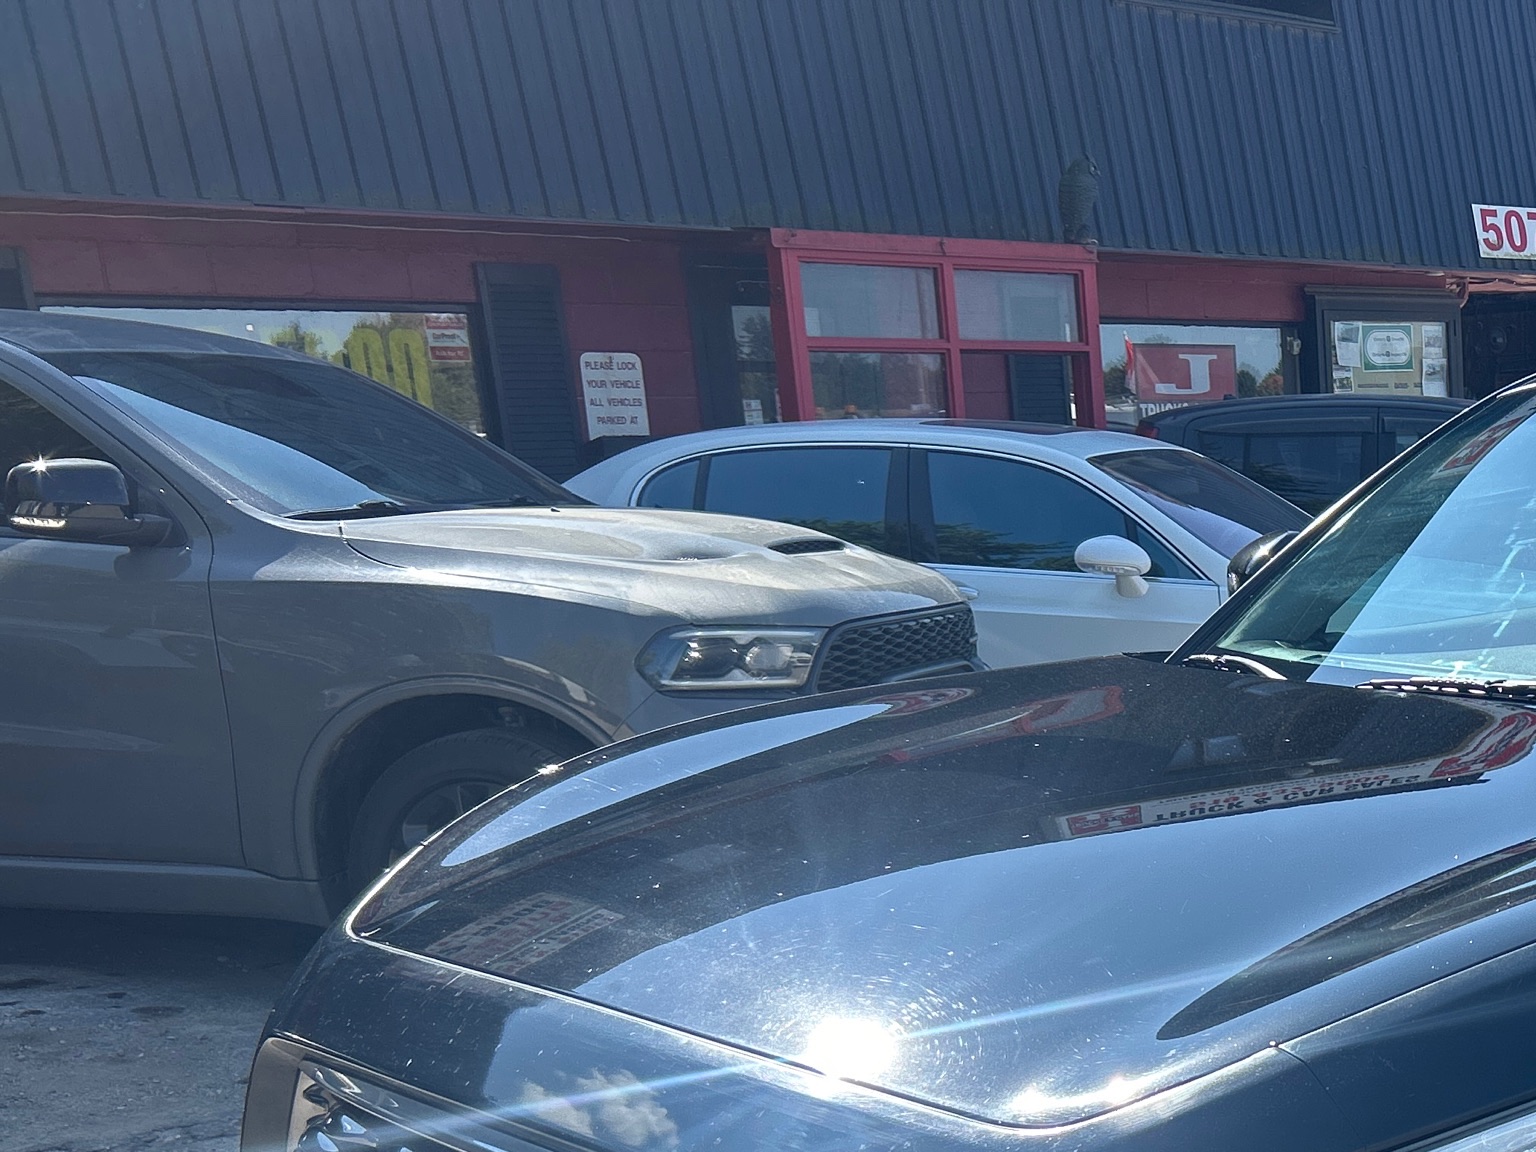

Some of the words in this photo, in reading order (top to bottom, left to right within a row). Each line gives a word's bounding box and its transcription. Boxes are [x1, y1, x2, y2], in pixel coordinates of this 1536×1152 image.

[584, 361, 614, 371] PLEASE
[617, 361, 638, 371] LOCK
[1155, 354, 1217, 395] J
[586, 379, 607, 388] YOUR
[610, 380, 641, 389] VEHICLE
[590, 398, 605, 407] ALL
[607, 397, 643, 407] VEHICLES
[597, 416, 627, 425] PARKED
[629, 415, 639, 425] AT
